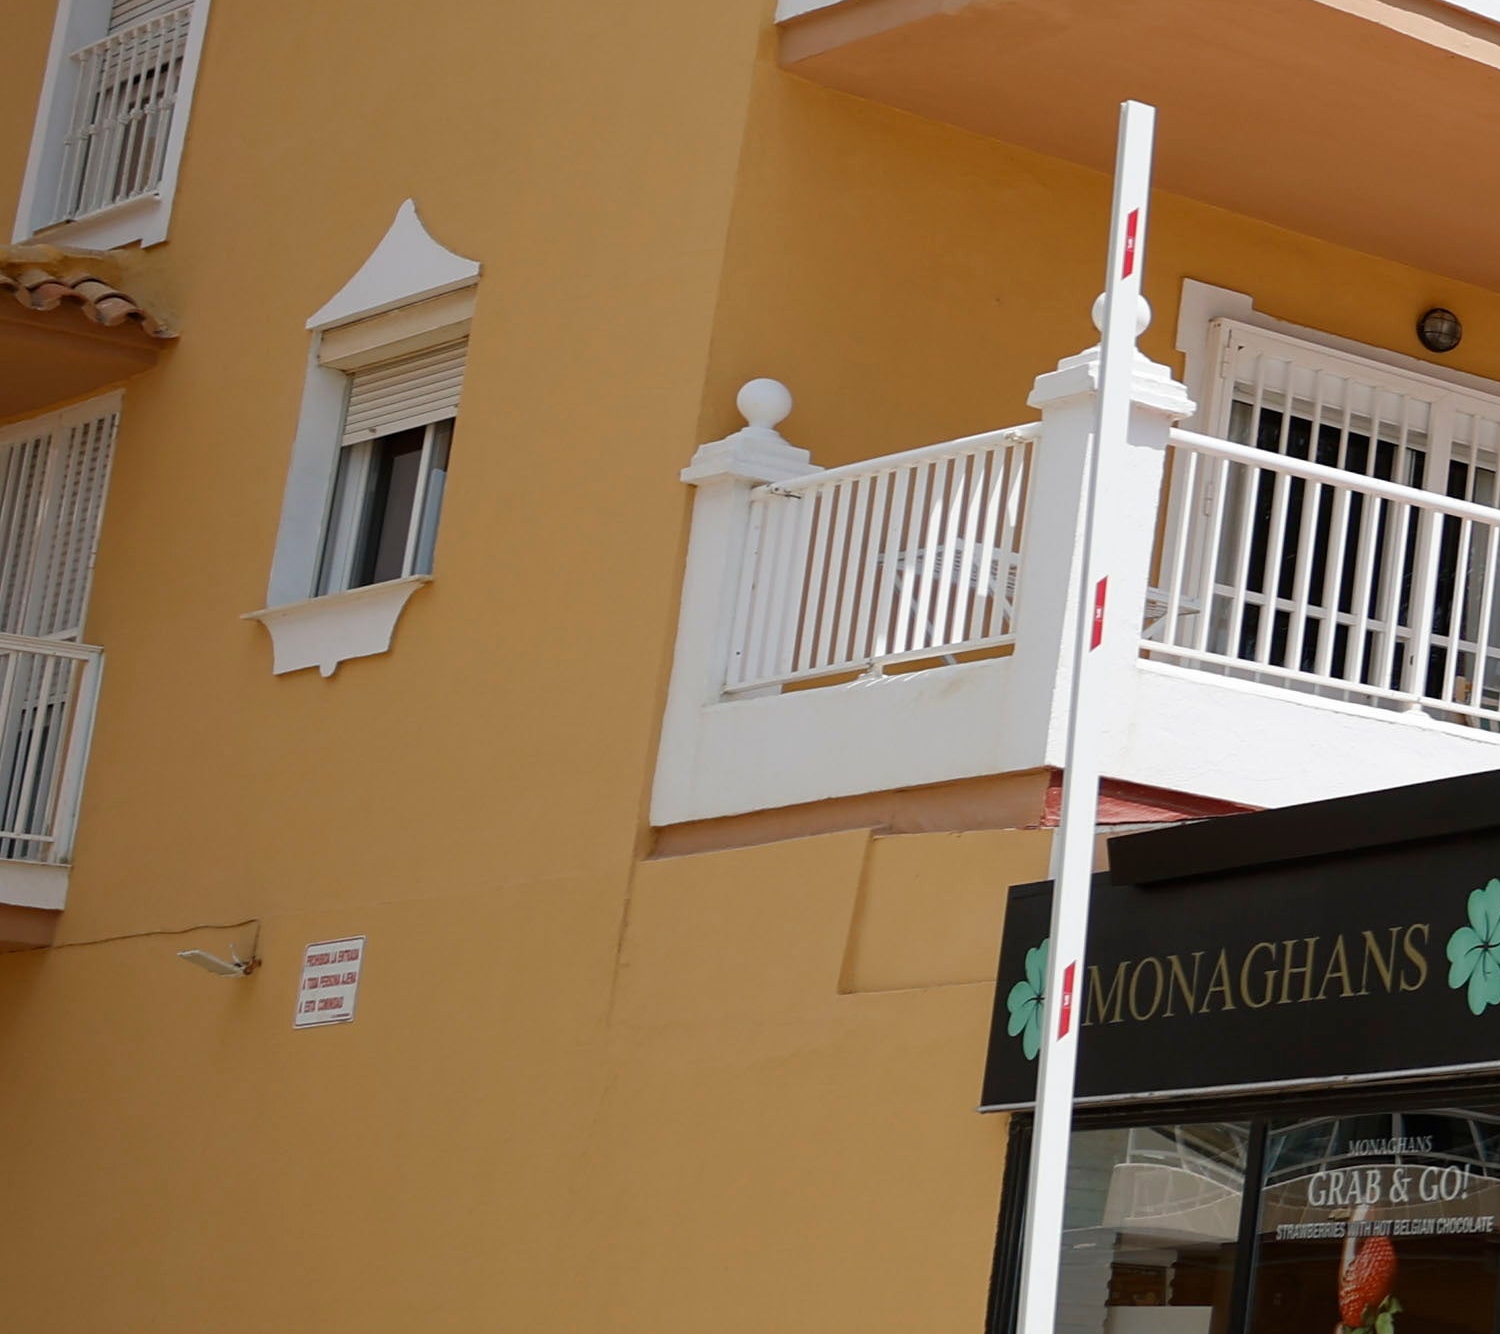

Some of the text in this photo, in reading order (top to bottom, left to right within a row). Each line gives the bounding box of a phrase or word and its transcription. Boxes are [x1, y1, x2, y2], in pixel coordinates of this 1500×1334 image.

[1082, 923, 1430, 1027] MONAGHANS
[1347, 1135, 1434, 1156] MONAGHANS
[1308, 1164, 1471, 1207] GRAB & GO!
[1276, 1215, 1495, 1241] STRAWBERRIES WITH HOT BELGIAN CHOCOLATE
